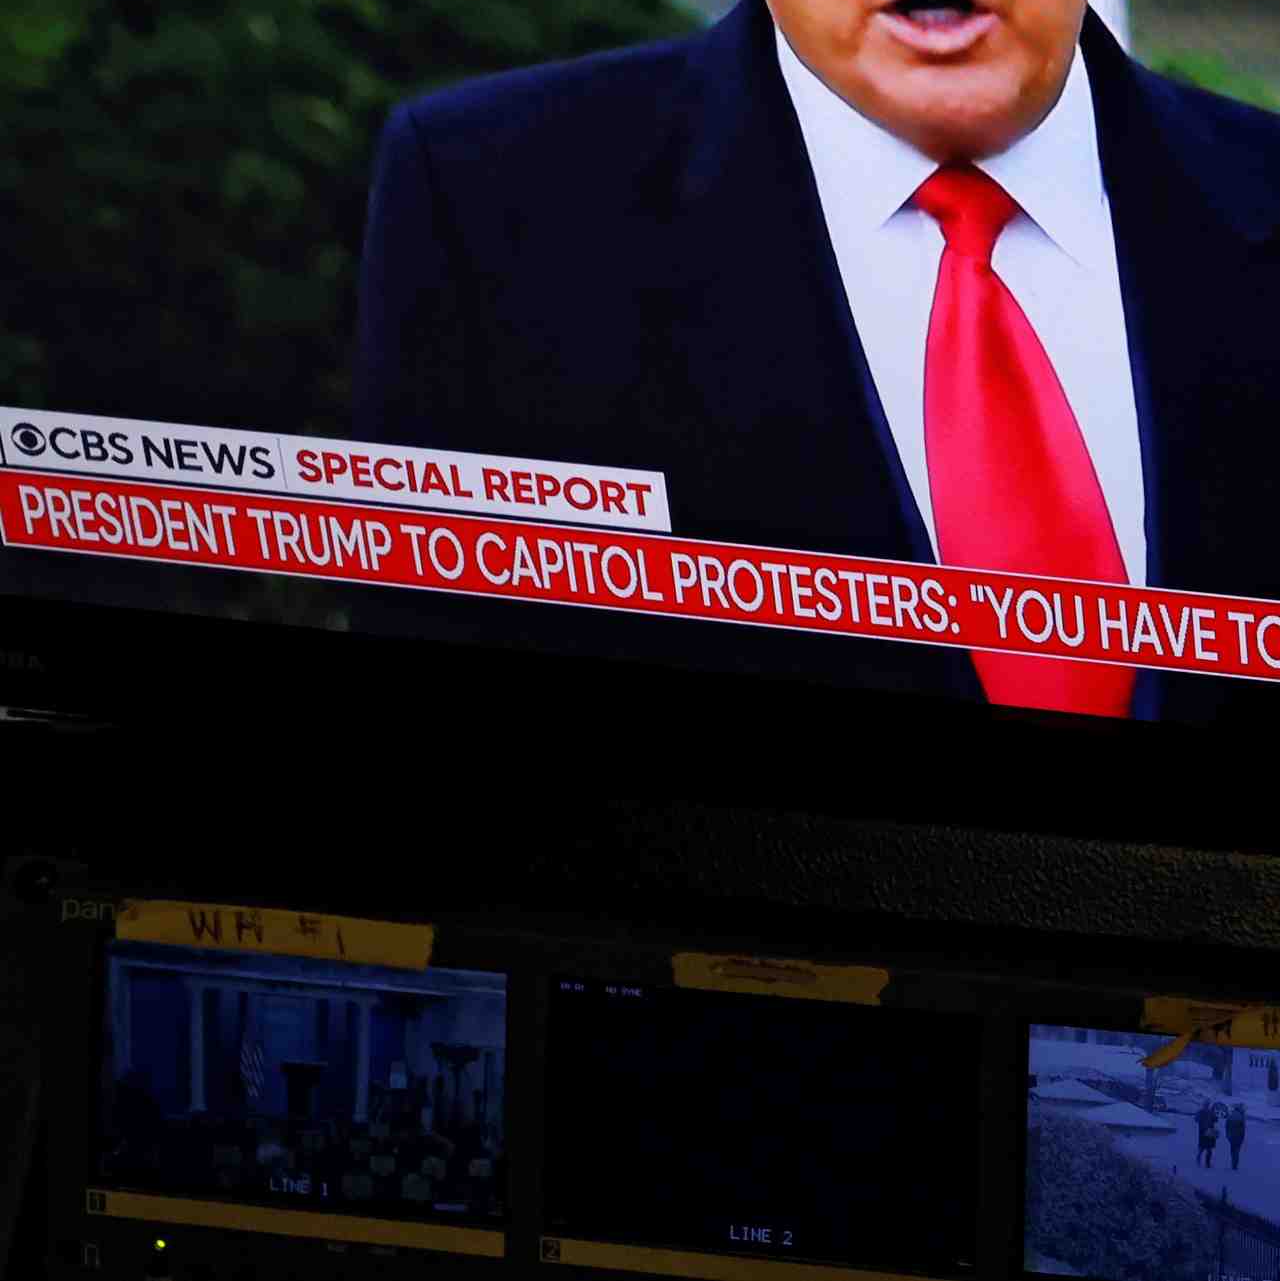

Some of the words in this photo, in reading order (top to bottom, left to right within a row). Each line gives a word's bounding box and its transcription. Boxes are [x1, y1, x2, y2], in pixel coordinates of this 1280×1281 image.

[48, 426, 134, 465] CBS
[140, 435, 276, 480] NEWS
[295, 449, 474, 499] SPECIAL
[481, 467, 652, 517] REPORT
[18, 485, 237, 556] PRESIDENT
[246, 508, 392, 571] TRUMP
[399, 524, 465, 580] TO
[475, 532, 664, 601] CAPITOL
[670, 552, 960, 634] PROTESTERS:
[970, 584, 1085, 647] "YOU
[1097, 597, 1219, 662] HAVE
[729, 1223, 774, 1244] LINE
[782, 1228, 794, 1247] 2
